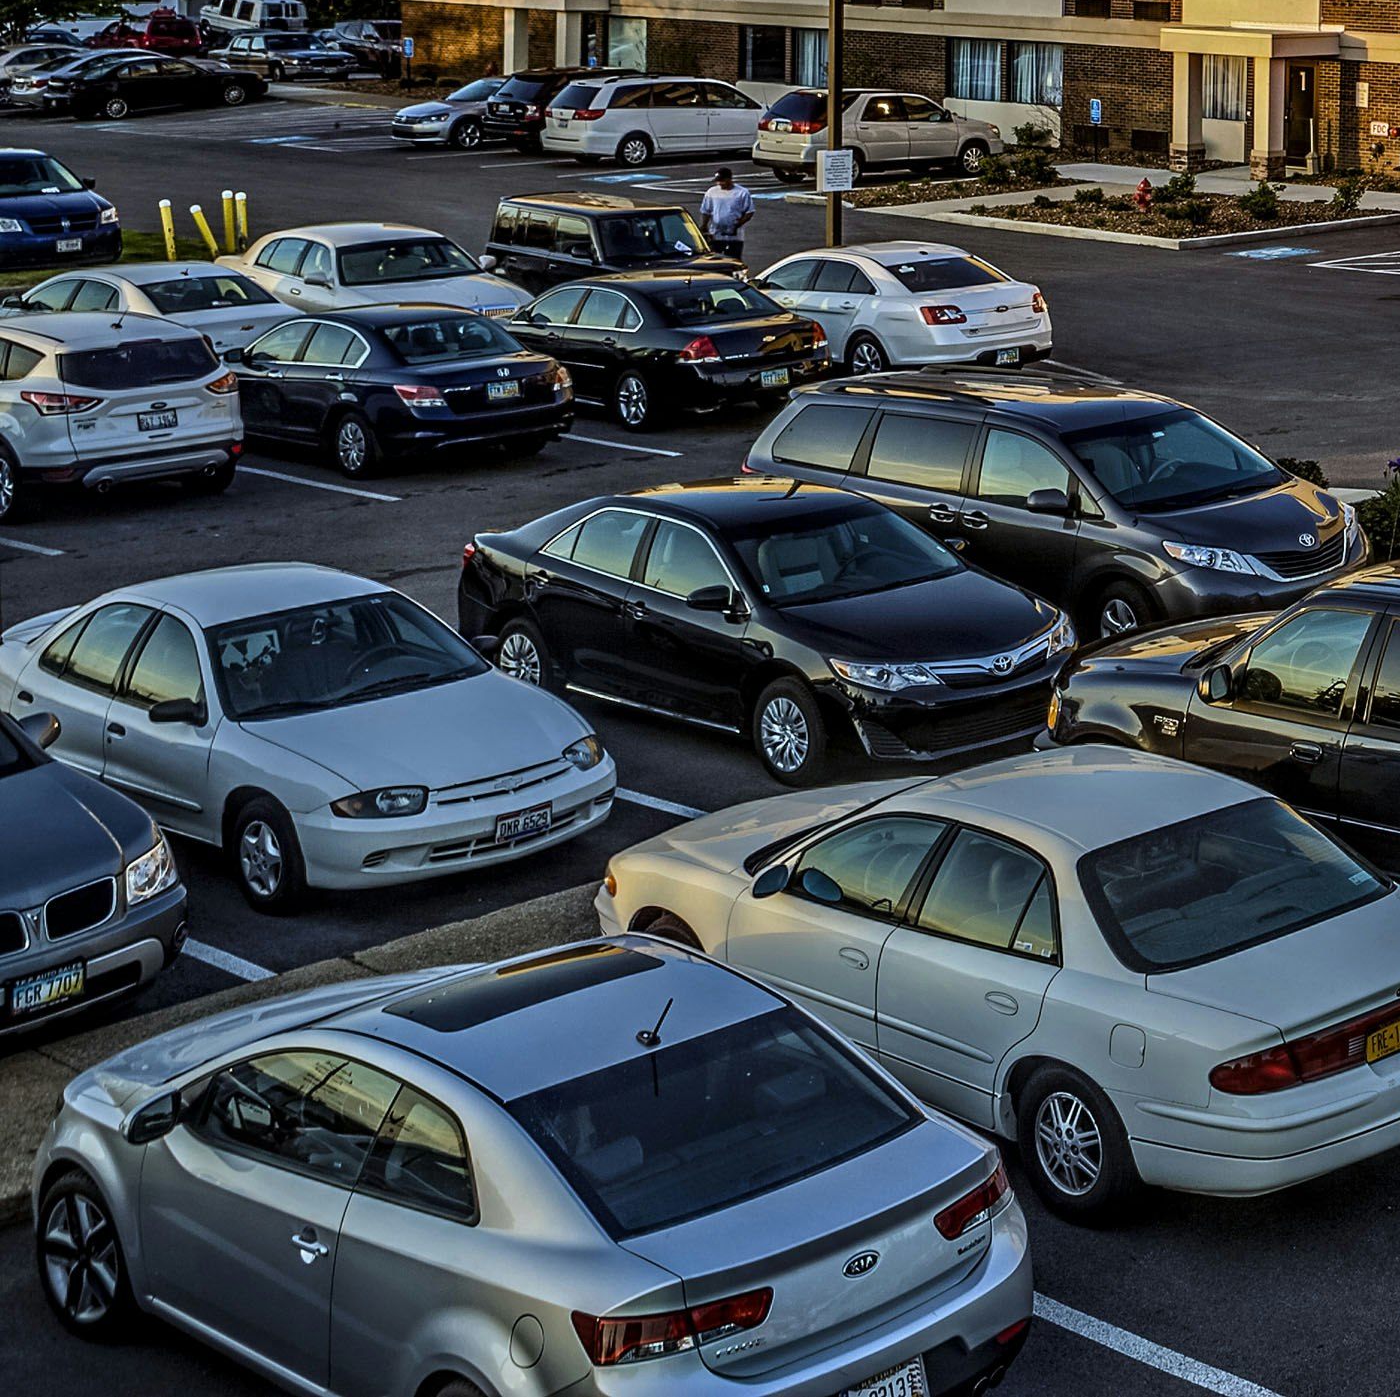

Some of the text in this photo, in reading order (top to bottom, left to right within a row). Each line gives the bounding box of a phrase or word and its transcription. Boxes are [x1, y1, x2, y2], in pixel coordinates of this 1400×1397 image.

[1372, 124, 1387, 134] FDC
[522, 810, 549, 831] 6529
[16, 983, 42, 1008] FGR
[46, 971, 81, 998] 7707
[1371, 1029, 1389, 1053] FRE
[850, 1254, 875, 1274] KIA
